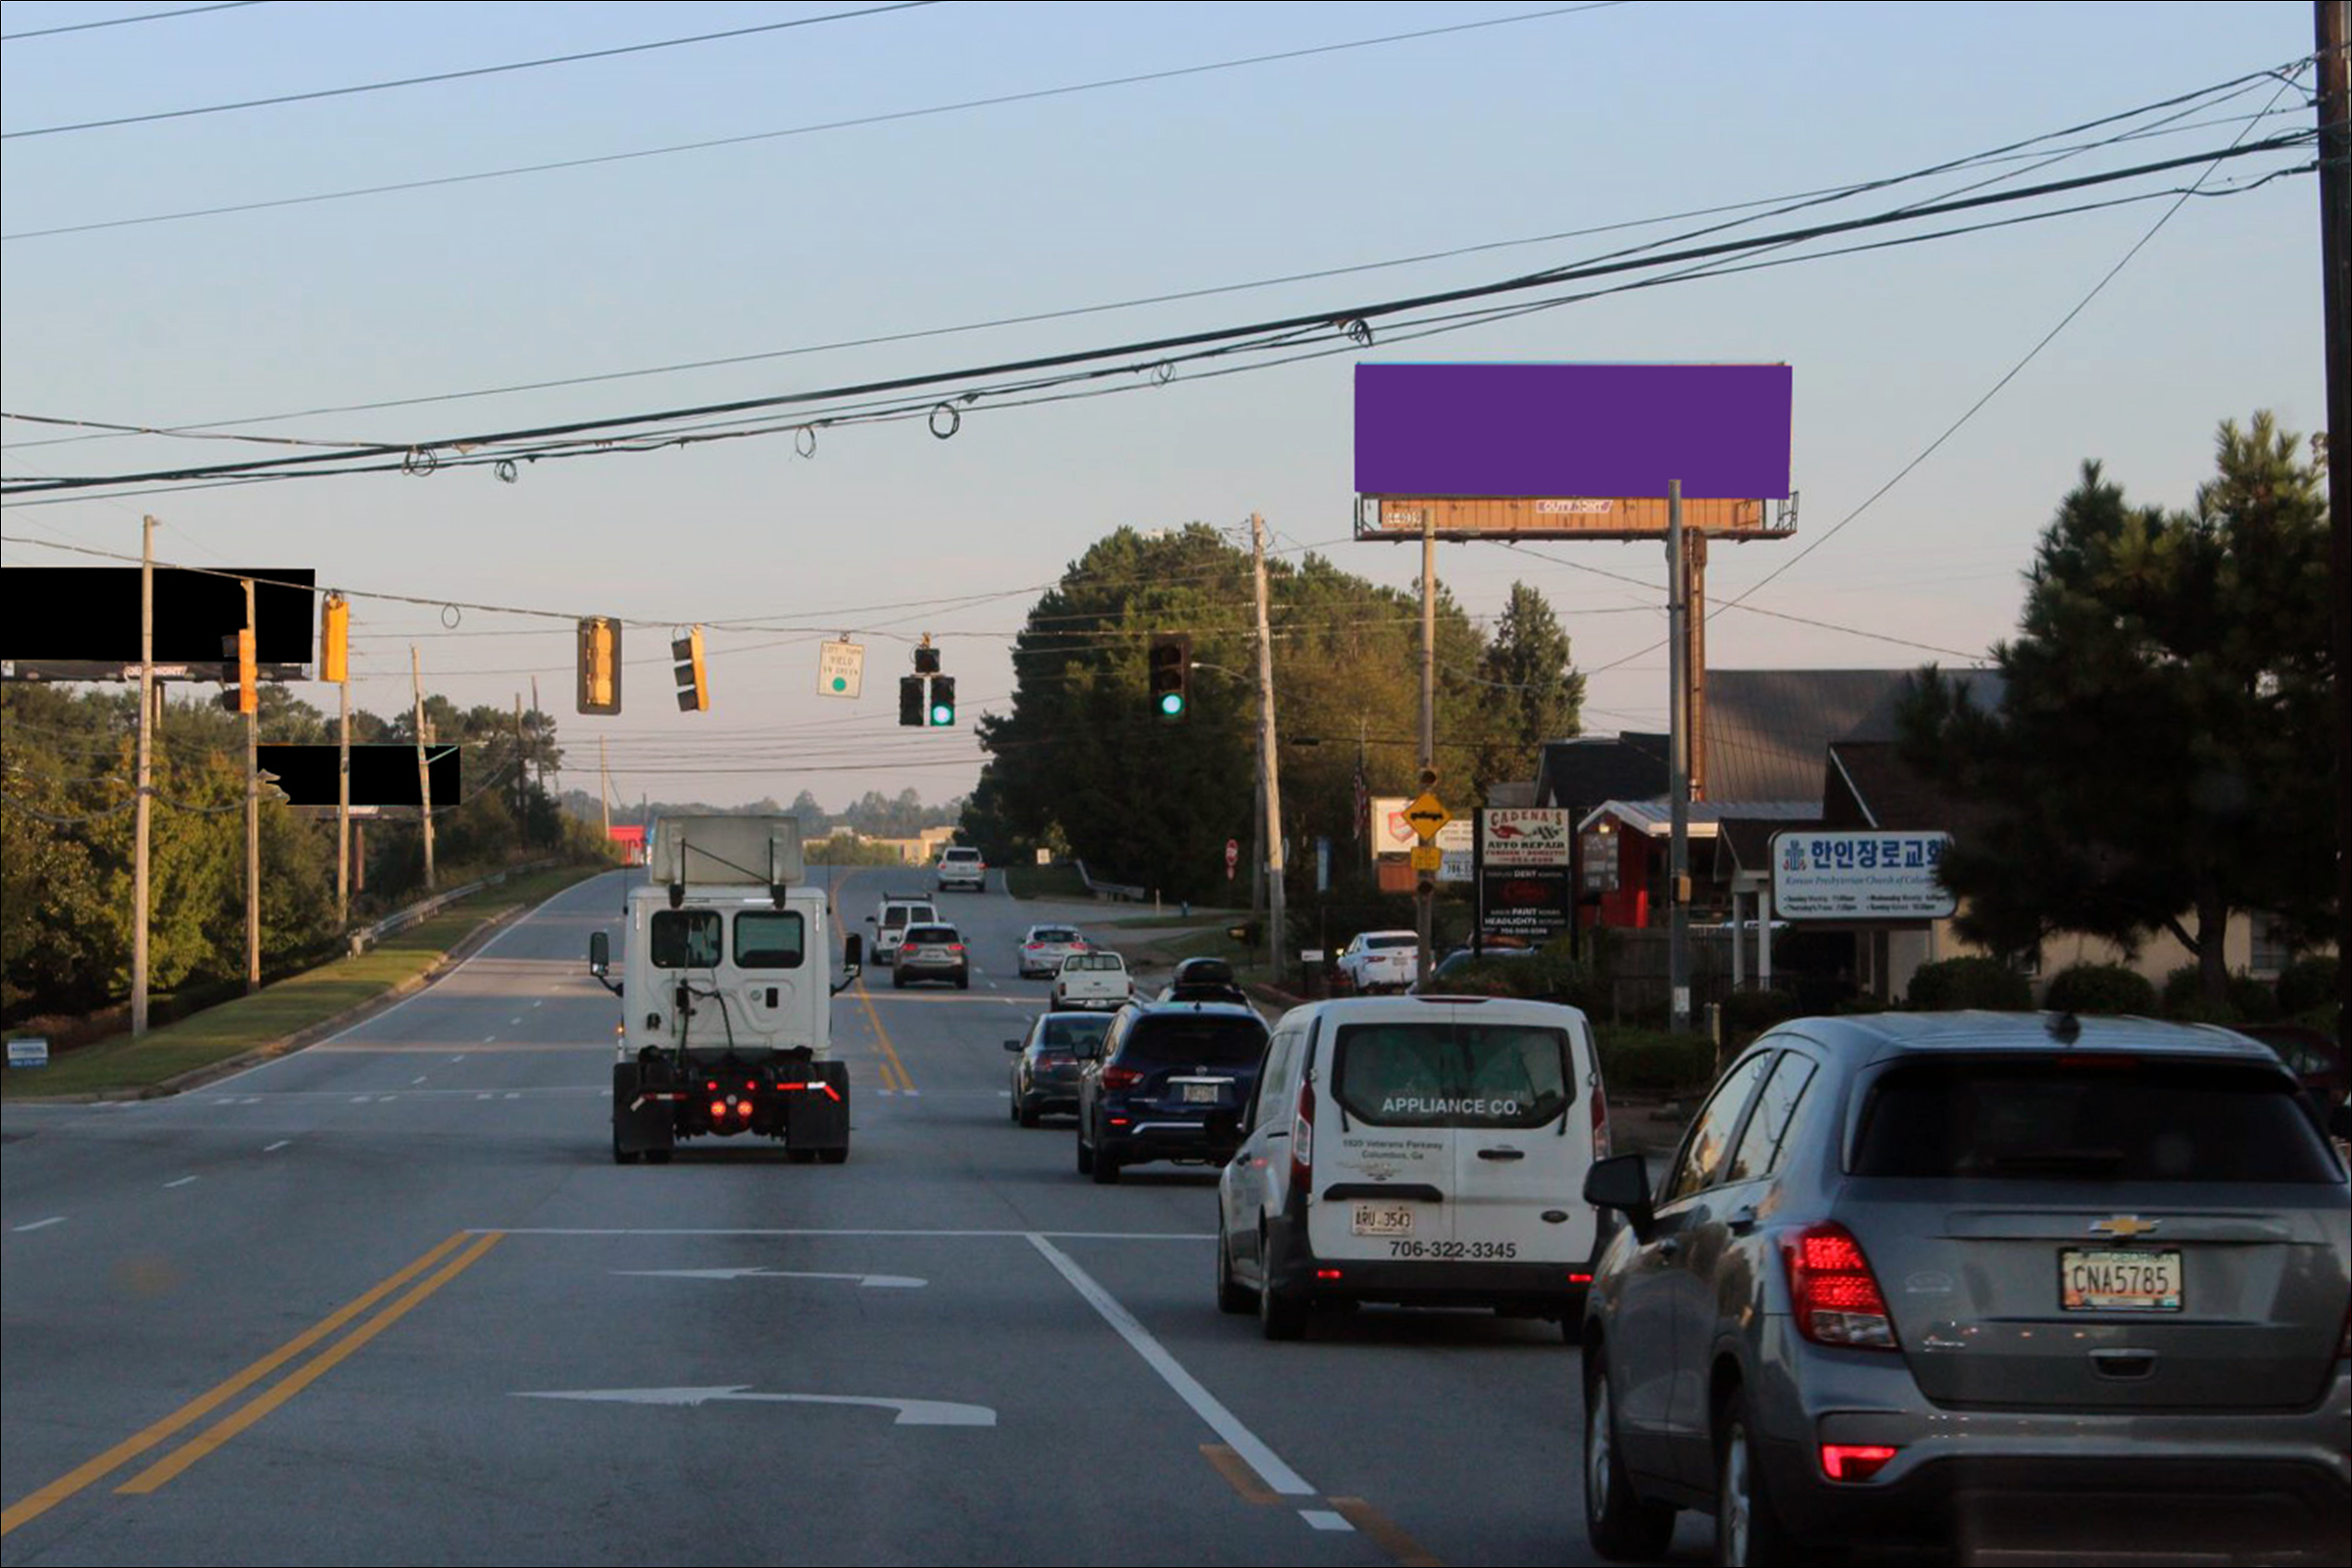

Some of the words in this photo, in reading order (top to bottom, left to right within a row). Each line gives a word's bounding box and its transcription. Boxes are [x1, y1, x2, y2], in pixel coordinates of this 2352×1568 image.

[830, 657, 854, 666] YIELD
[1491, 810, 1562, 826] CADENA'S
[1811, 839, 1946, 869] 한인장로교회
[1514, 869, 1538, 878] DENT
[1786, 876, 1814, 885] Korean
[1815, 876, 1864, 887] Presbyterian
[1866, 875, 1893, 885] Church
[1905, 876, 1936, 885] Colum
[1511, 907, 1538, 916] PAINT
[1382, 1098, 1486, 1114] APPLIANCE
[1491, 1099, 1522, 1116] CO.
[1366, 1140, 1403, 1149] Veterans
[1406, 1140, 1445, 1152] Parkway
[1384, 1212, 1411, 1228] 3543
[1391, 1241, 1517, 1258] 706-322-3345
[2111, 1252, 2175, 1264] GEORGIA
[2074, 1265, 2169, 1295] CNA5785
